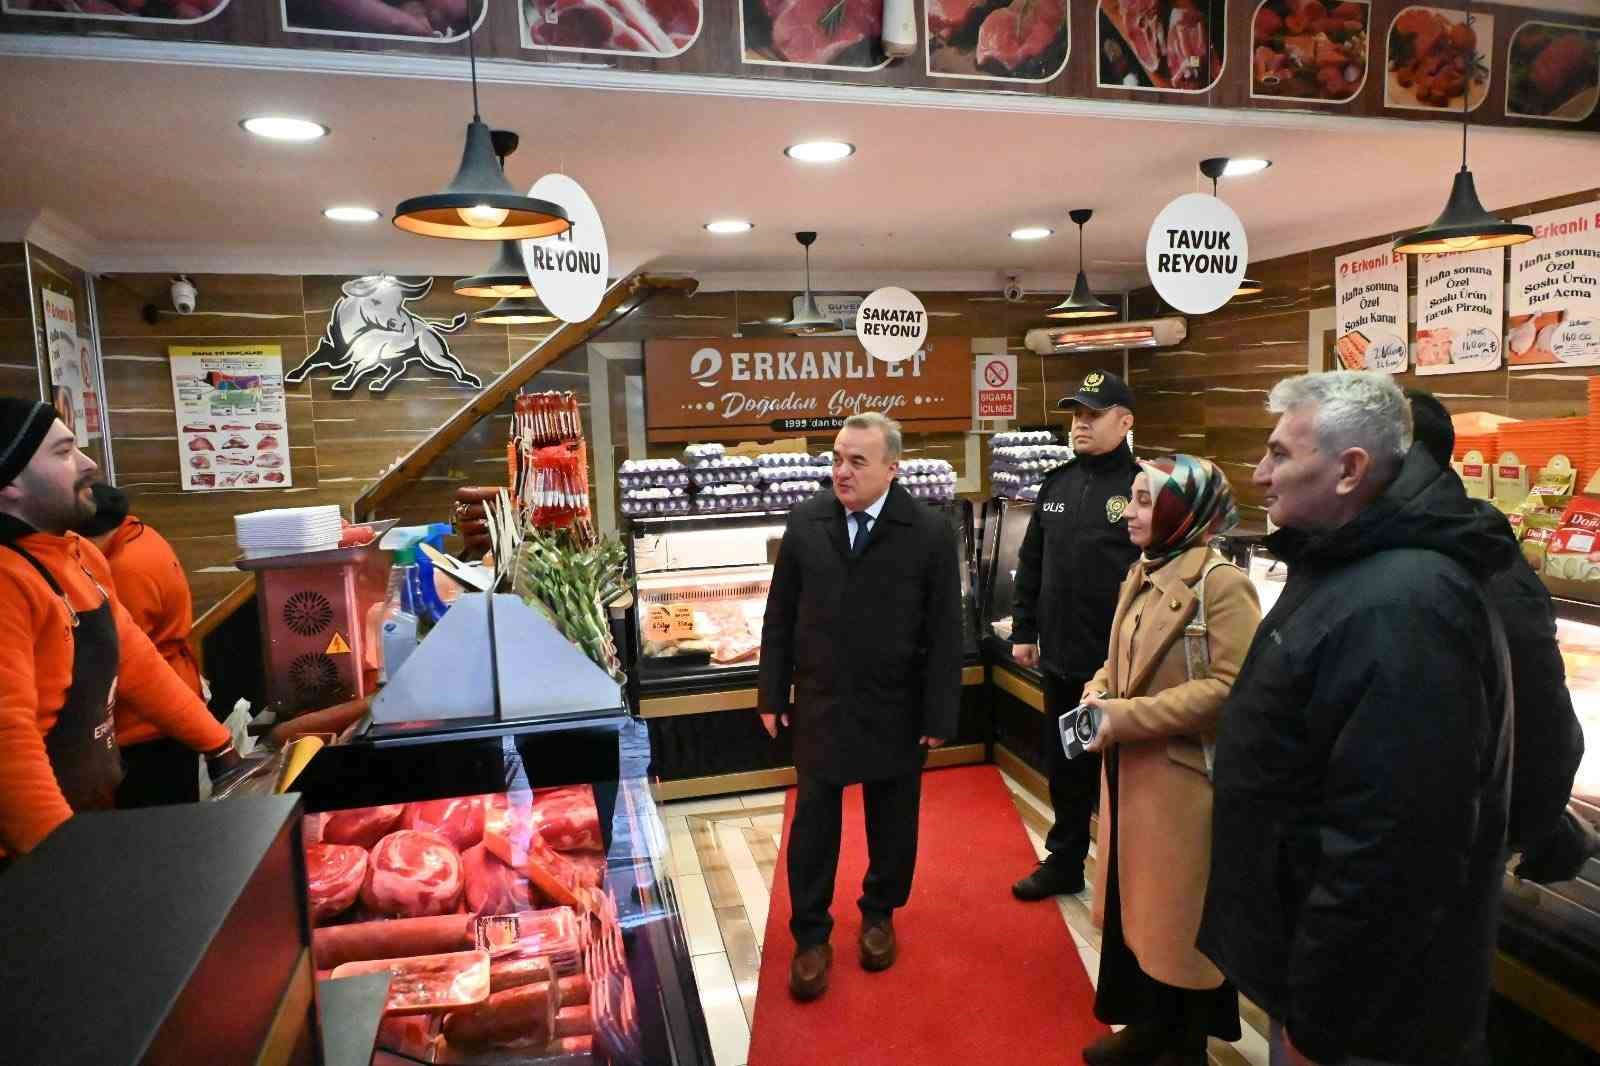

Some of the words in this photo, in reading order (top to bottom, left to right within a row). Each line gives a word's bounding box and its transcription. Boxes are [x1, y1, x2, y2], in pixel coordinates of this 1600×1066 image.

[1535, 216, 1588, 240] Erkanlı
[1166, 229, 1231, 250] TAVUK
[533, 245, 601, 275] REYONU
[1158, 253, 1238, 274] REYONU
[1352, 253, 1388, 274] Erkanlı
[1520, 253, 1551, 273] Hafta
[1546, 260, 1575, 273] Özel
[1425, 270, 1451, 288] Hafta
[1453, 266, 1493, 276] sonuna
[1446, 277, 1470, 289] Özel
[1524, 277, 1560, 295] Soslu
[1563, 272, 1597, 286] Ürün
[1342, 286, 1364, 305] Hafta
[1365, 282, 1399, 293] sonuna
[1360, 296, 1380, 310] Özel
[1429, 293, 1457, 309] Soslu
[1459, 287, 1487, 301] Ürün
[1528, 291, 1550, 306] But
[862, 308, 924, 323] SAKATAT
[1456, 302, 1493, 316] Pirzola
[863, 322, 921, 338] REYONU
[1345, 315, 1368, 333] Soslu
[1370, 312, 1397, 325] Kanat
[731, 351, 875, 381] ERKANLI
[720, 391, 818, 418] Doğadan
[827, 388, 906, 416] Sofraya
